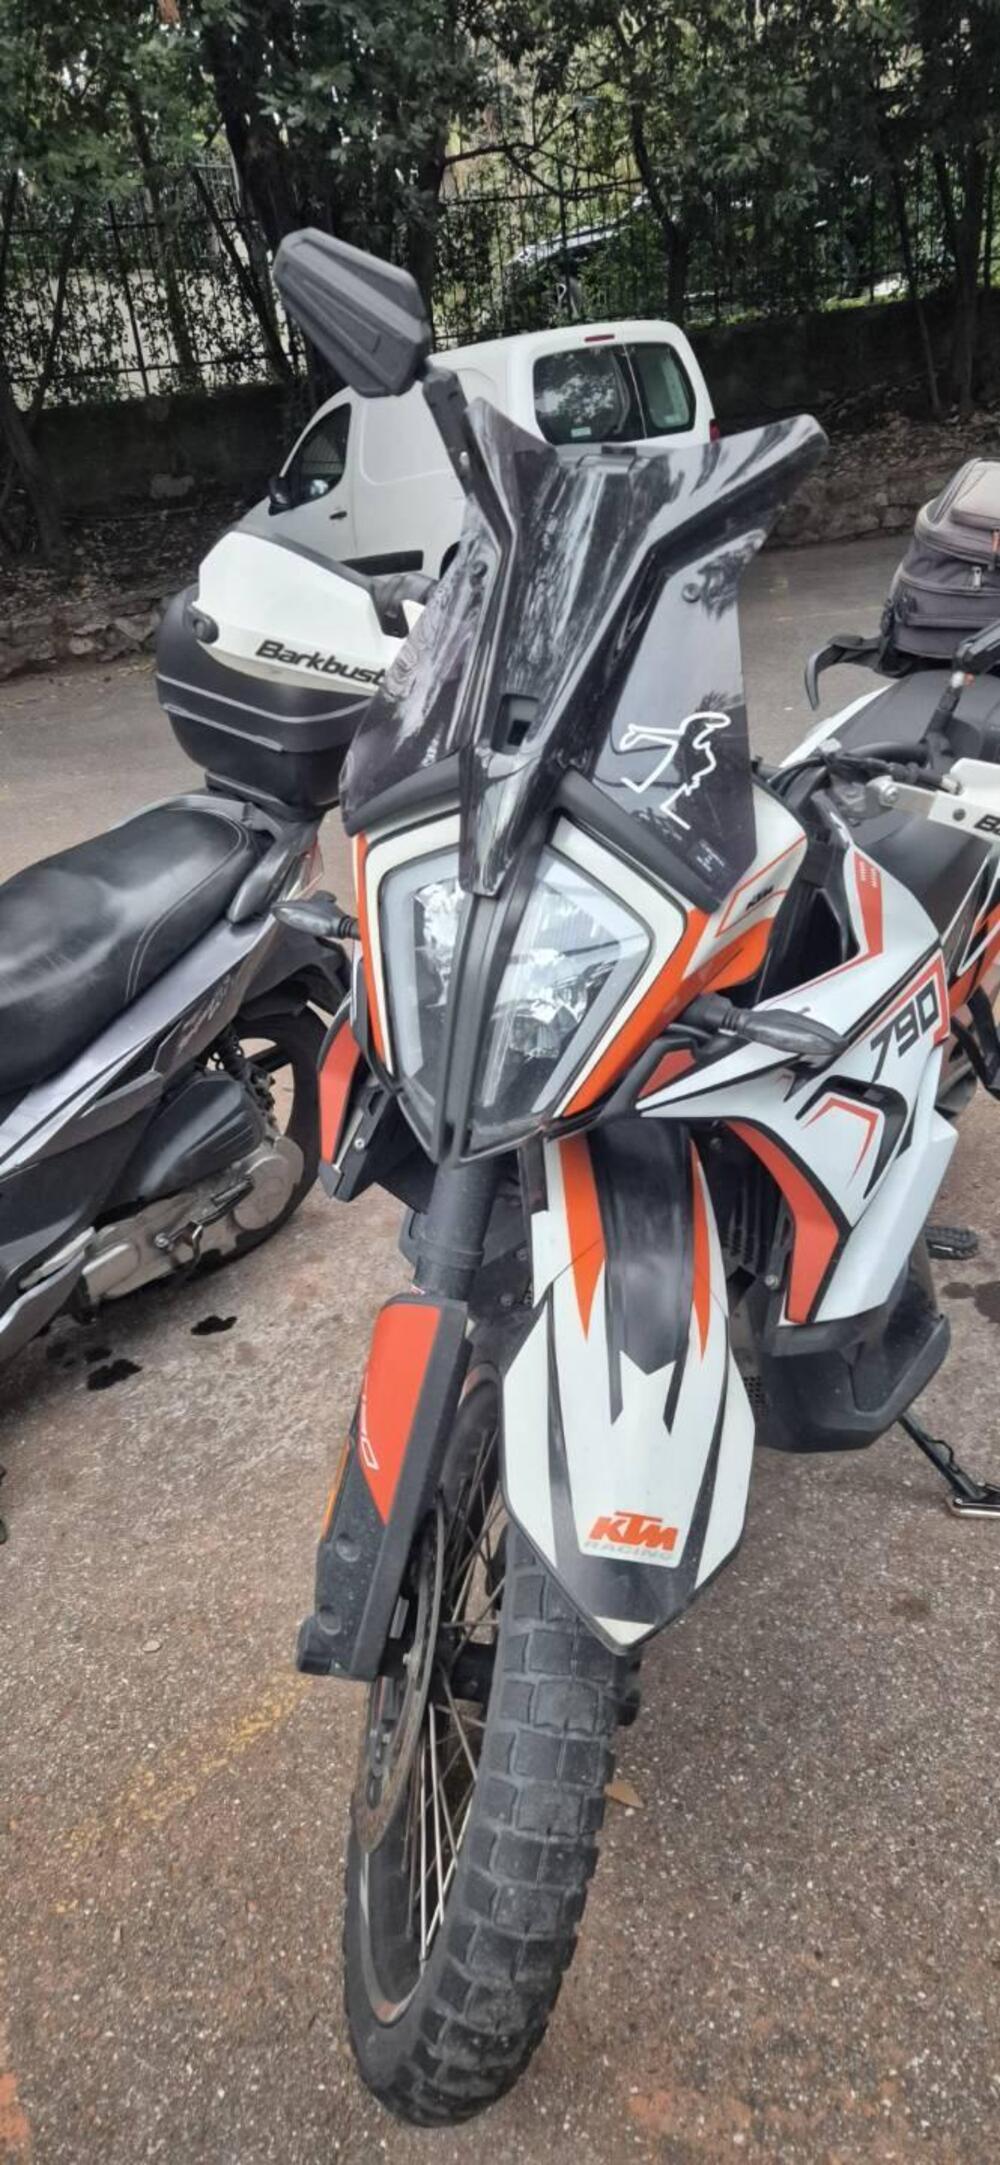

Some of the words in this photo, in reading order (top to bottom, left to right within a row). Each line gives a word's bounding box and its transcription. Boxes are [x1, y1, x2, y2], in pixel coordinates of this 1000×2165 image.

[870, 979, 940, 1084] 790
[583, 1540, 673, 1561] RACING
[589, 1510, 679, 1552] KTM
